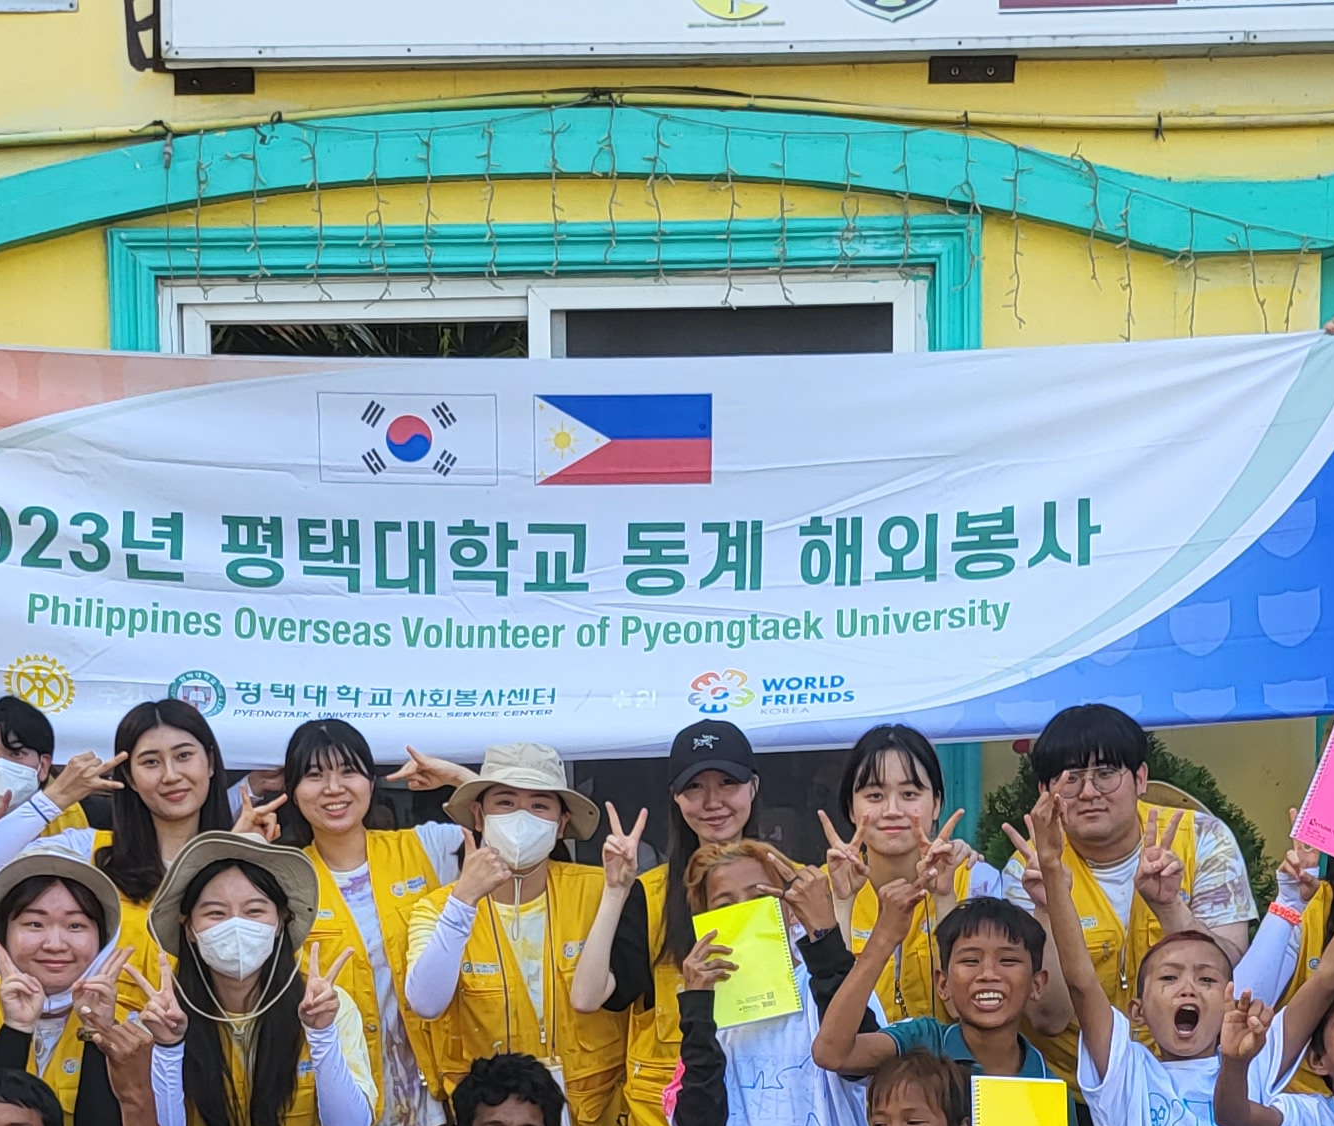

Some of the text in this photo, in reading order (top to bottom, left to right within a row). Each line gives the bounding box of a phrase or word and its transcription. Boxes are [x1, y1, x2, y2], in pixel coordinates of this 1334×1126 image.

[221, 514, 590, 597] 평택대학교
[622, 520, 763, 597] 동계
[799, 497, 1102, 587] 해외봉사
[27, 593, 1011, 652] Philippines Overseas Volunteer of Pyeongtaek University
[762, 675, 845, 692] WORLD
[761, 690, 855, 706] FRIENDS
[233, 709, 554, 720] PYEONGTAEK UNIVERSITY SOCIAL SERVICE CENTER
[760, 706, 810, 715] KOREA
